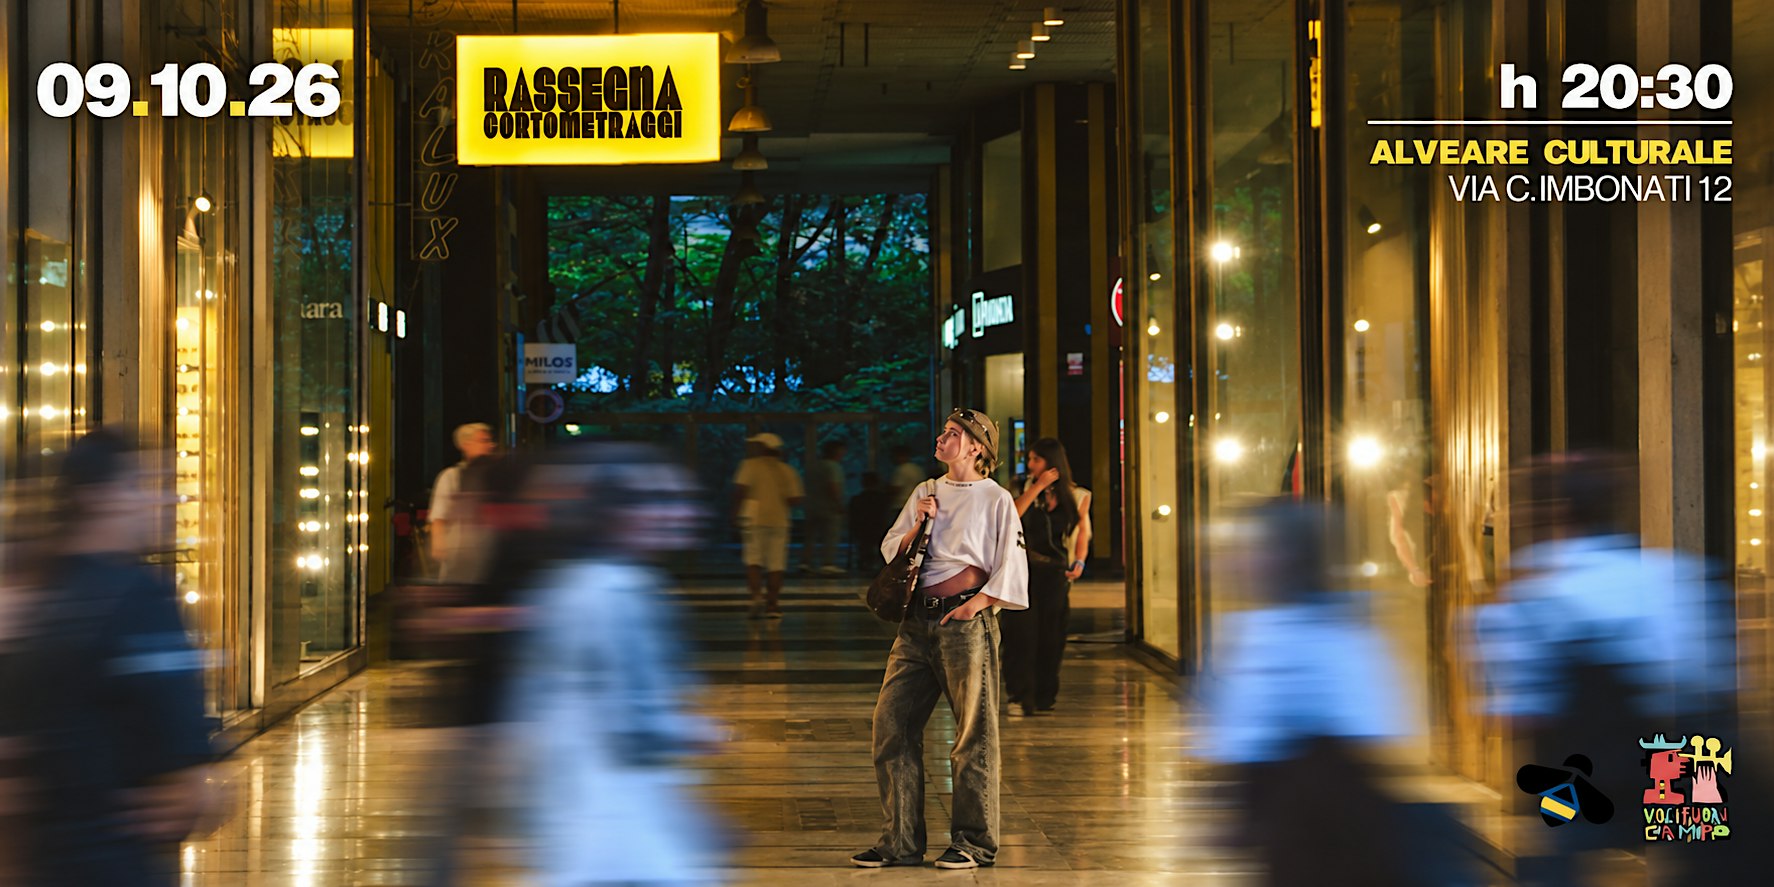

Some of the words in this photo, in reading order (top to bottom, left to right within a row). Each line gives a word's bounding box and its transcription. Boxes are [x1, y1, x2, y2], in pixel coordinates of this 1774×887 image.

[484, 65, 683, 113] RASSEGNA
[484, 111, 682, 139] CORTOMETRAGGI
[300, 302, 343, 319] ara
[524, 356, 573, 368] MILOS
